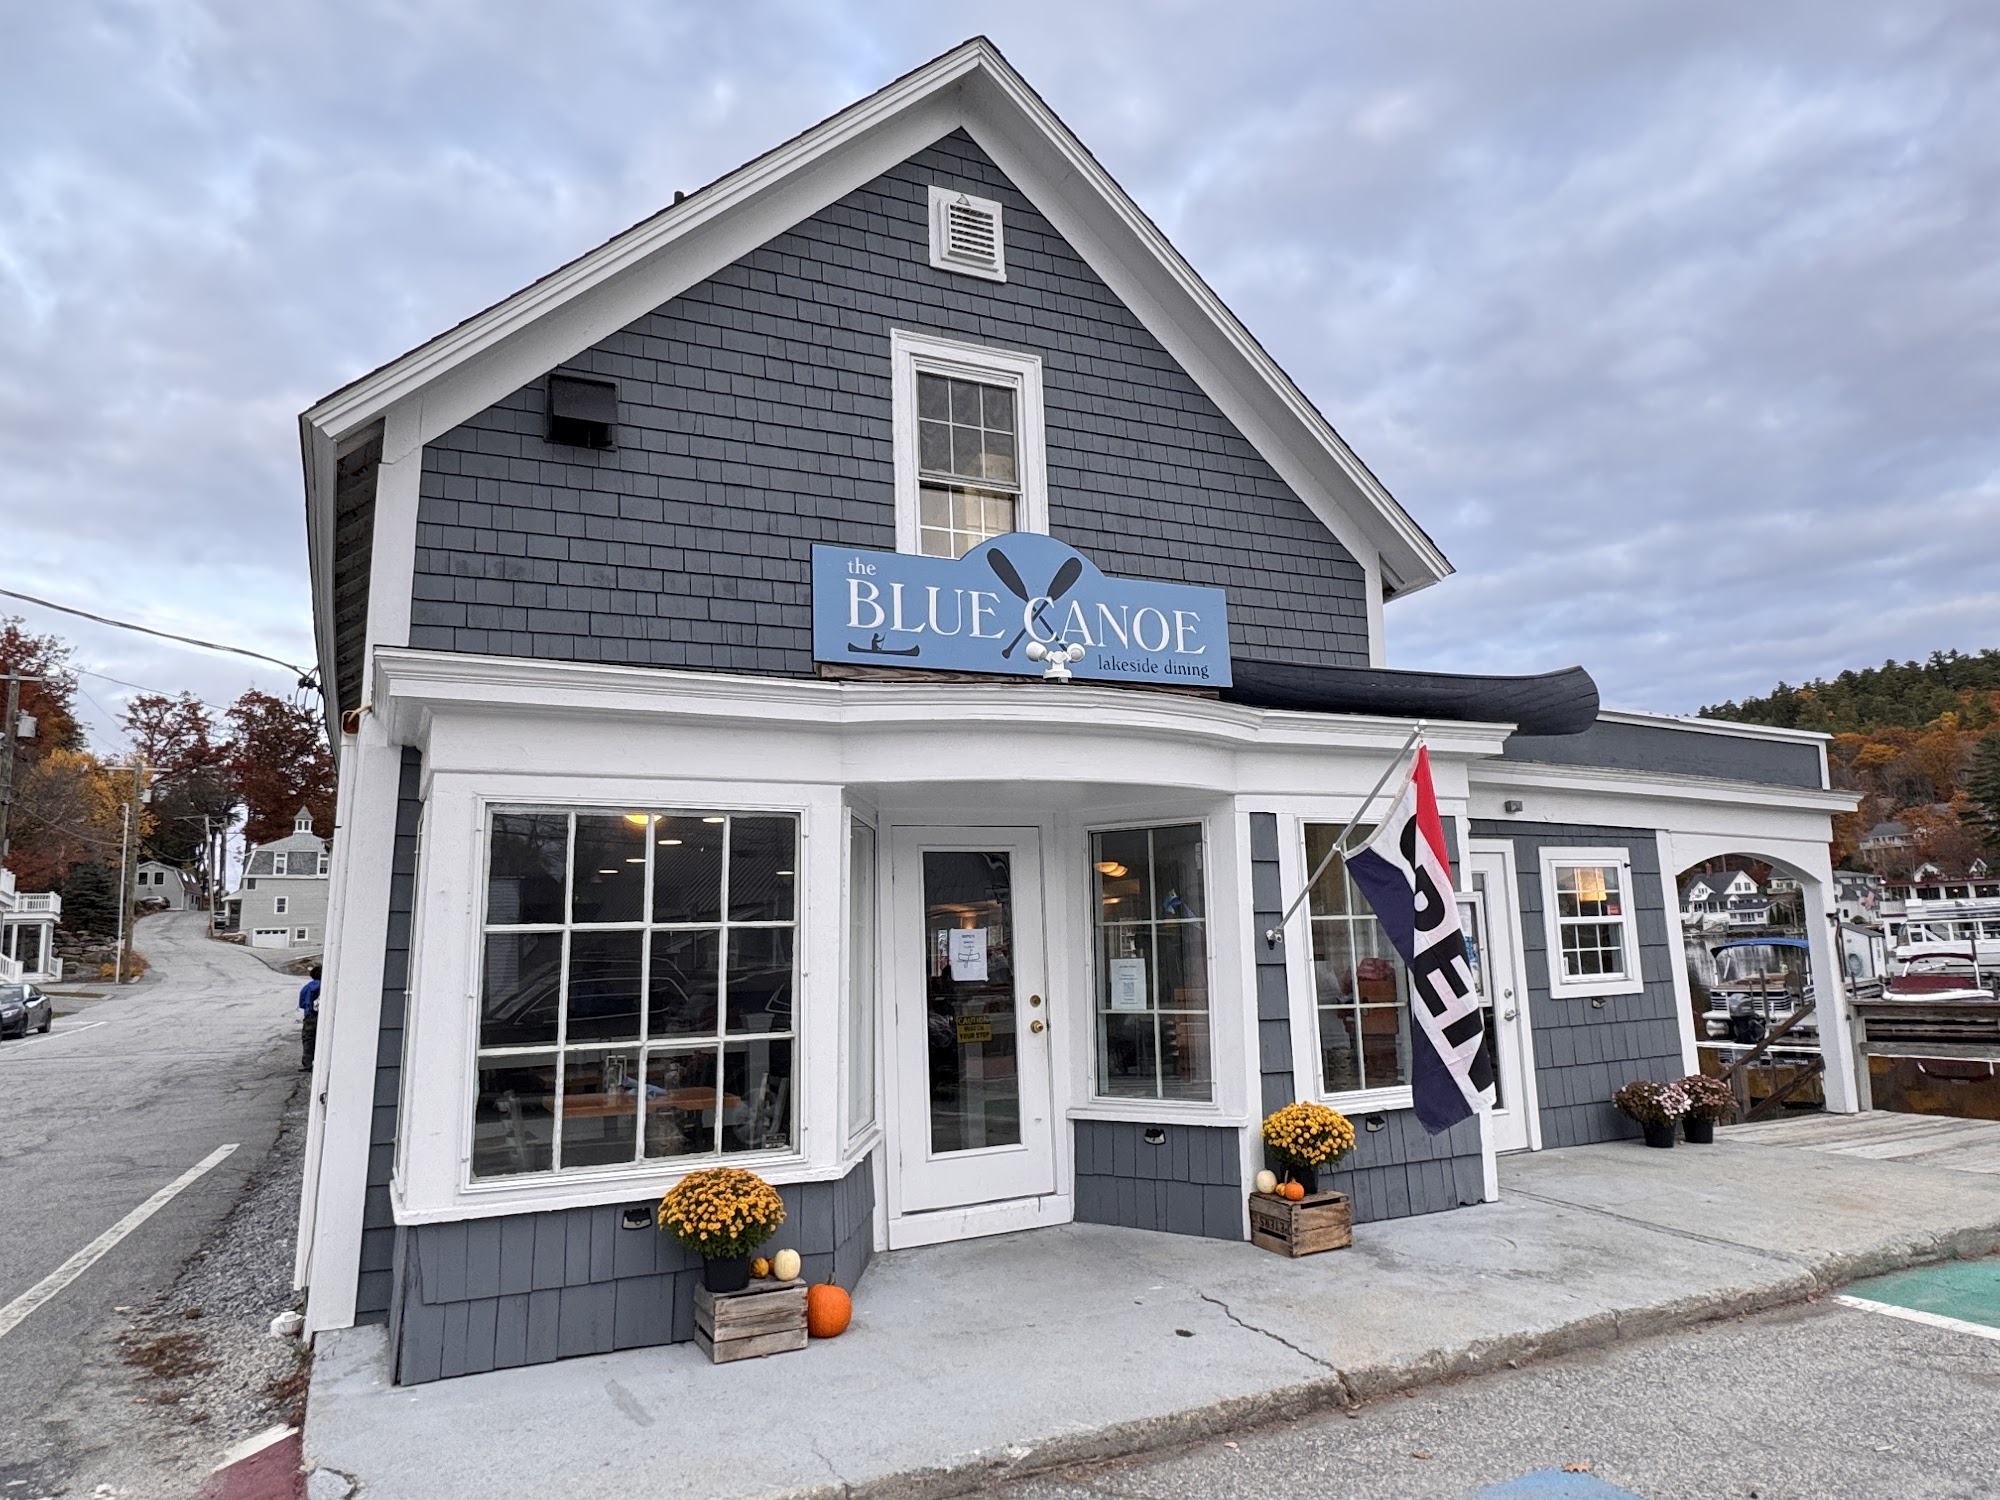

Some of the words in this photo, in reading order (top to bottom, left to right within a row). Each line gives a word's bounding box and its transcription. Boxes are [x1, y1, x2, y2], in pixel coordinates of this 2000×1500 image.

[847, 557, 877, 576] the
[846, 578, 1006, 639] BLUE
[1023, 595, 1207, 655] CANOE
[1098, 654, 1159, 674] lakeside
[1164, 659, 1210, 680] dining
[958, 1016, 990, 1025] CAUTION
